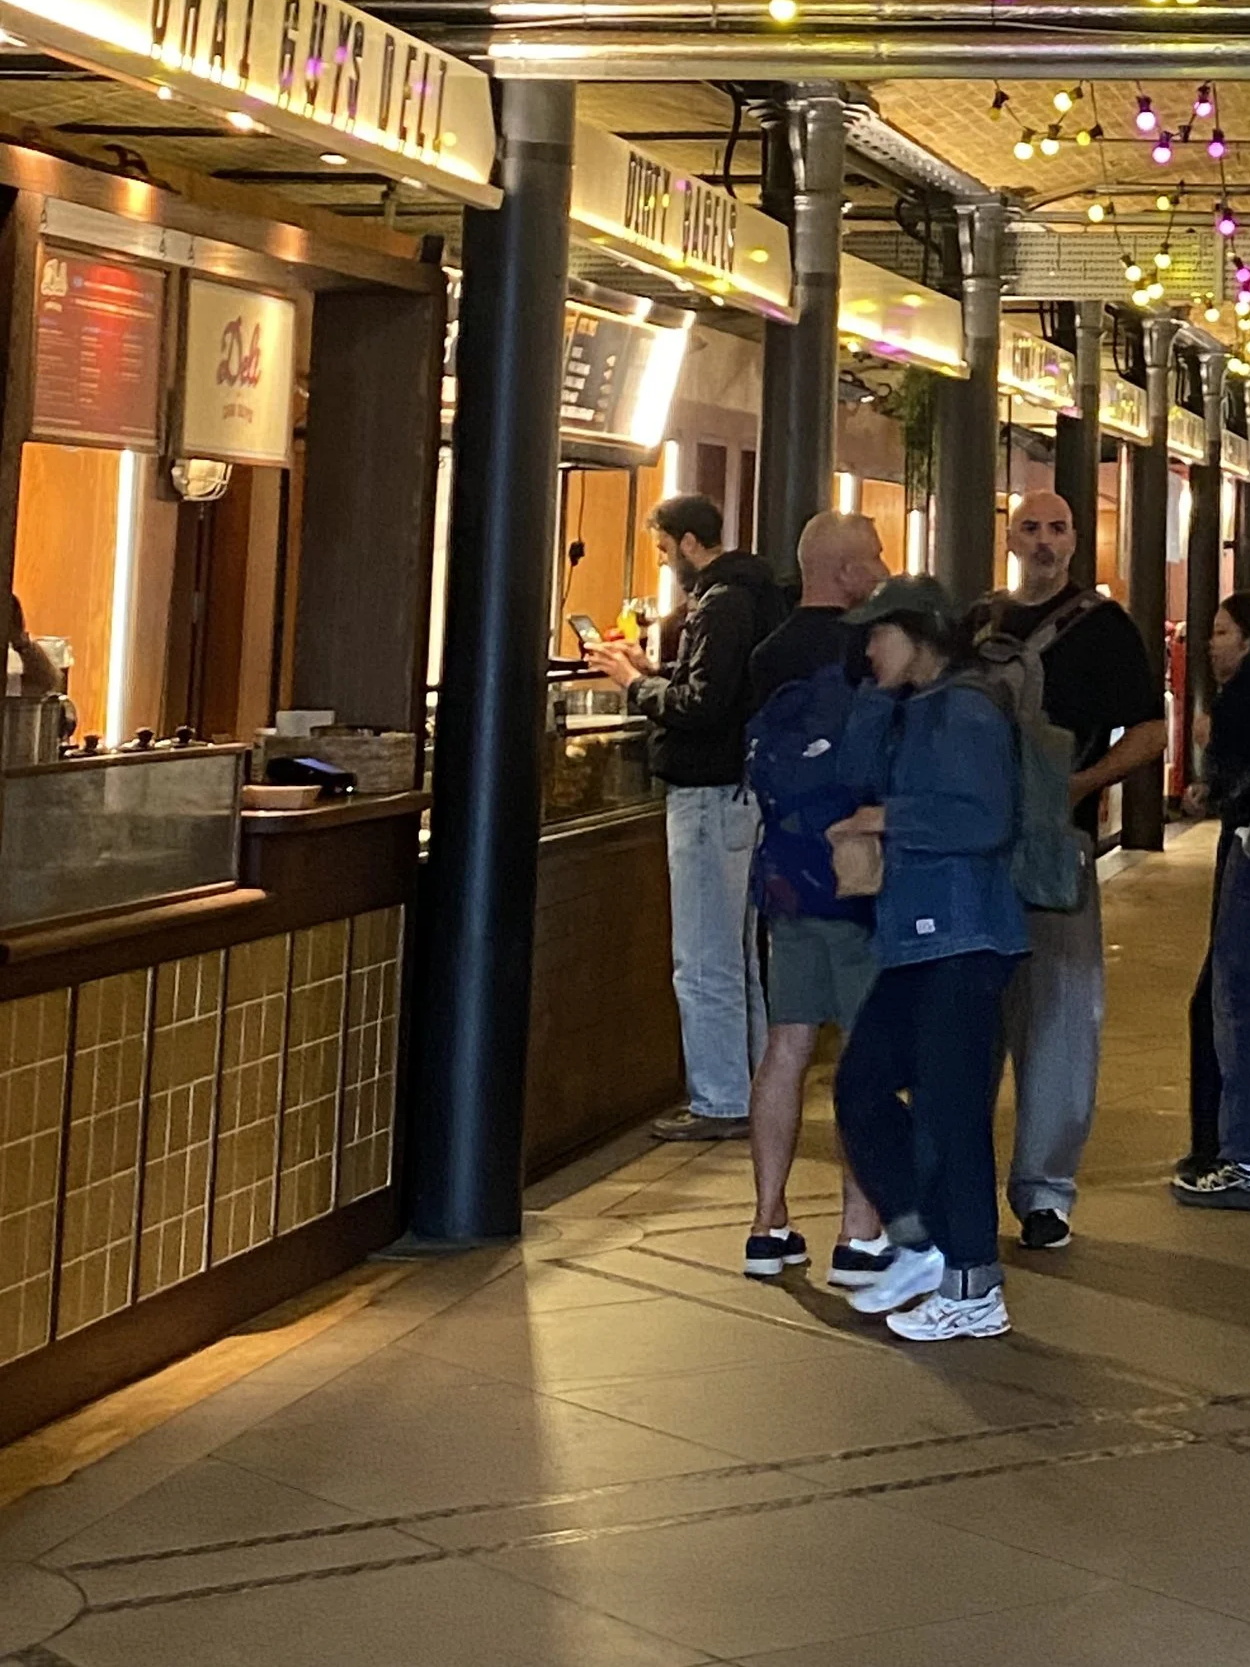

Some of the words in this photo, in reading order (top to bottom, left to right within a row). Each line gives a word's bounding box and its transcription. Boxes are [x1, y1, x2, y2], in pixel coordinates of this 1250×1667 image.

[378, 33, 447, 158] DELI
[624, 151, 671, 245] DIRTY
[682, 180, 737, 274] BAGELS
